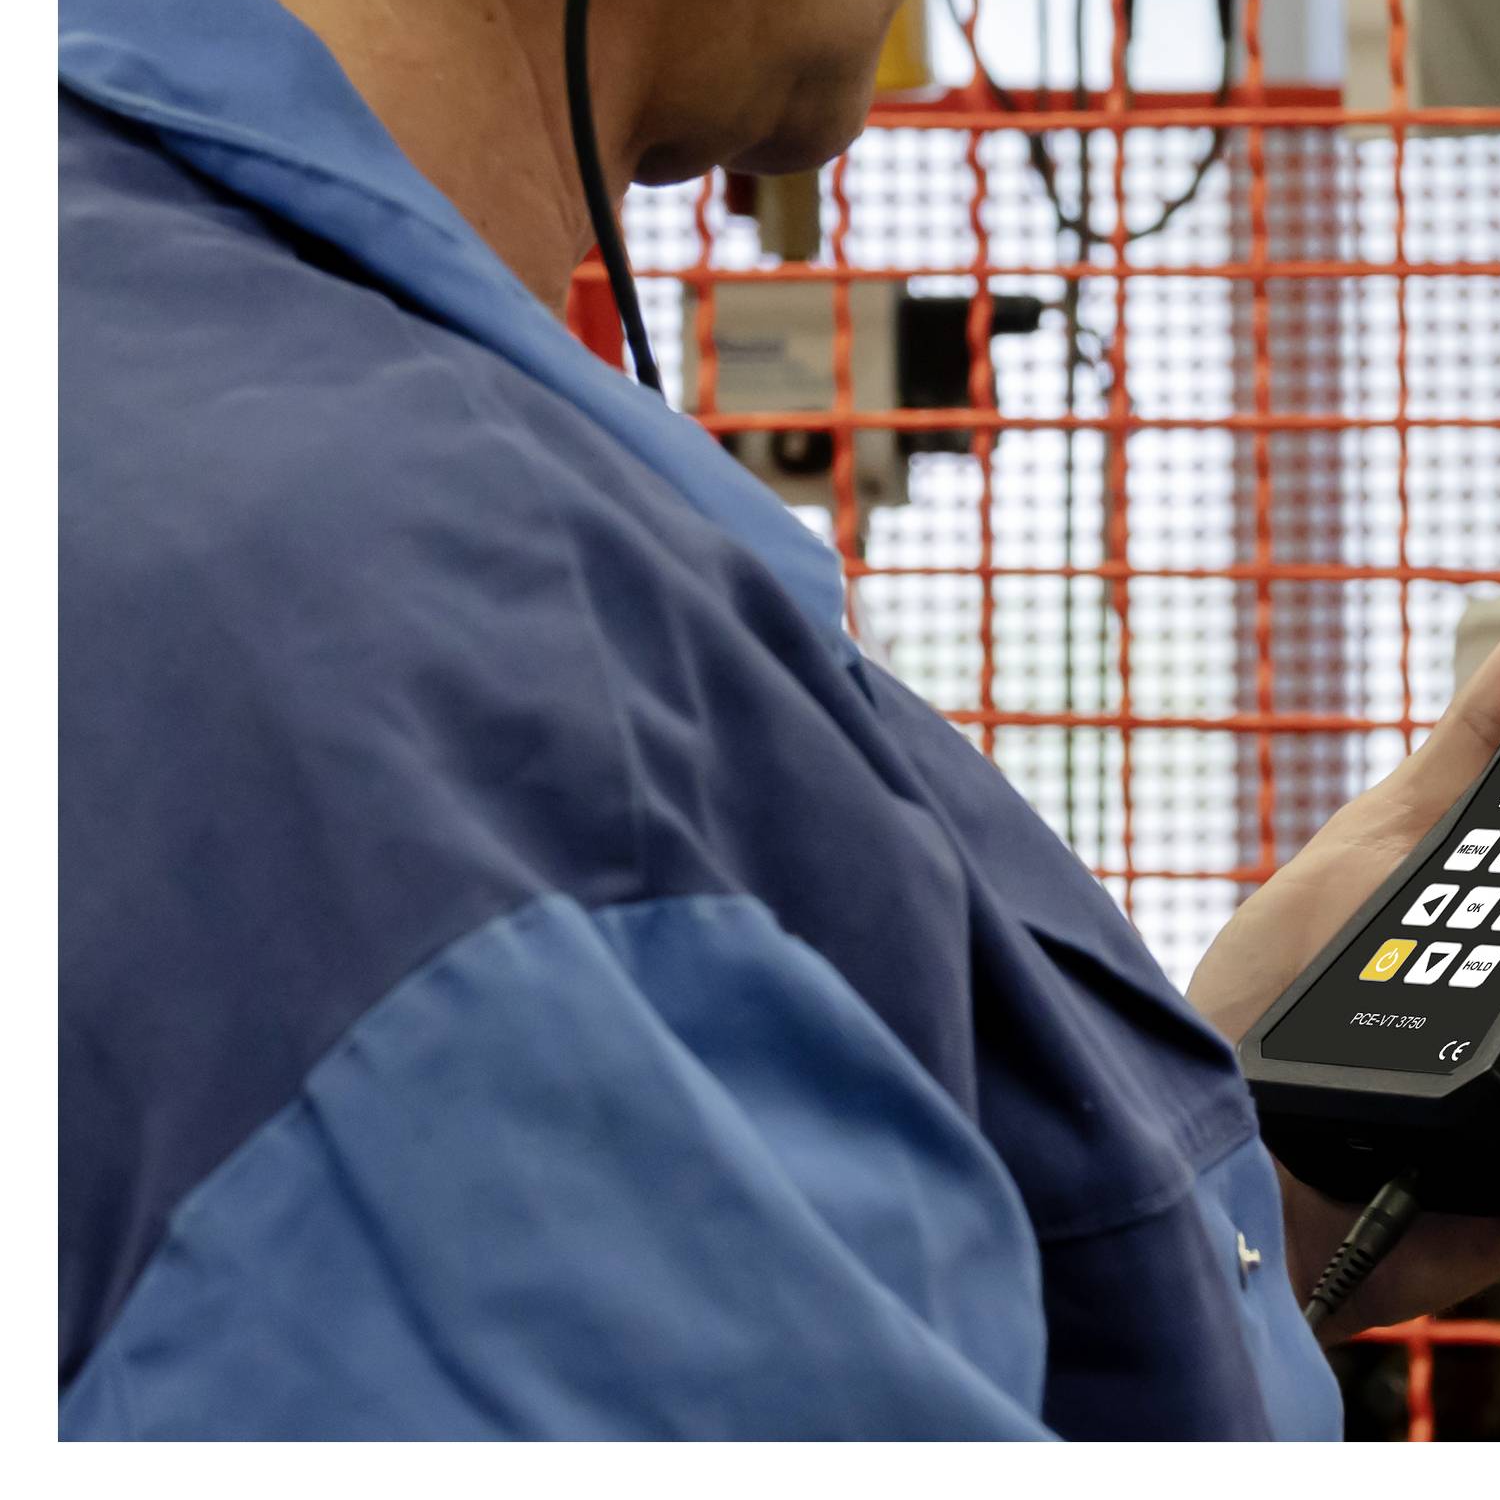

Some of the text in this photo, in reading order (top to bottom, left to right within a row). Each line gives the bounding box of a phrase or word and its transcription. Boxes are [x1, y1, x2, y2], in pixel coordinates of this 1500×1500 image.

[1456, 844, 1489, 855] MENU
[1466, 902, 1485, 913] OK
[1462, 960, 1493, 972] HOLD
[1349, 1012, 1427, 1029] PCE-VT 3750
[1438, 1040, 1471, 1062] CE
